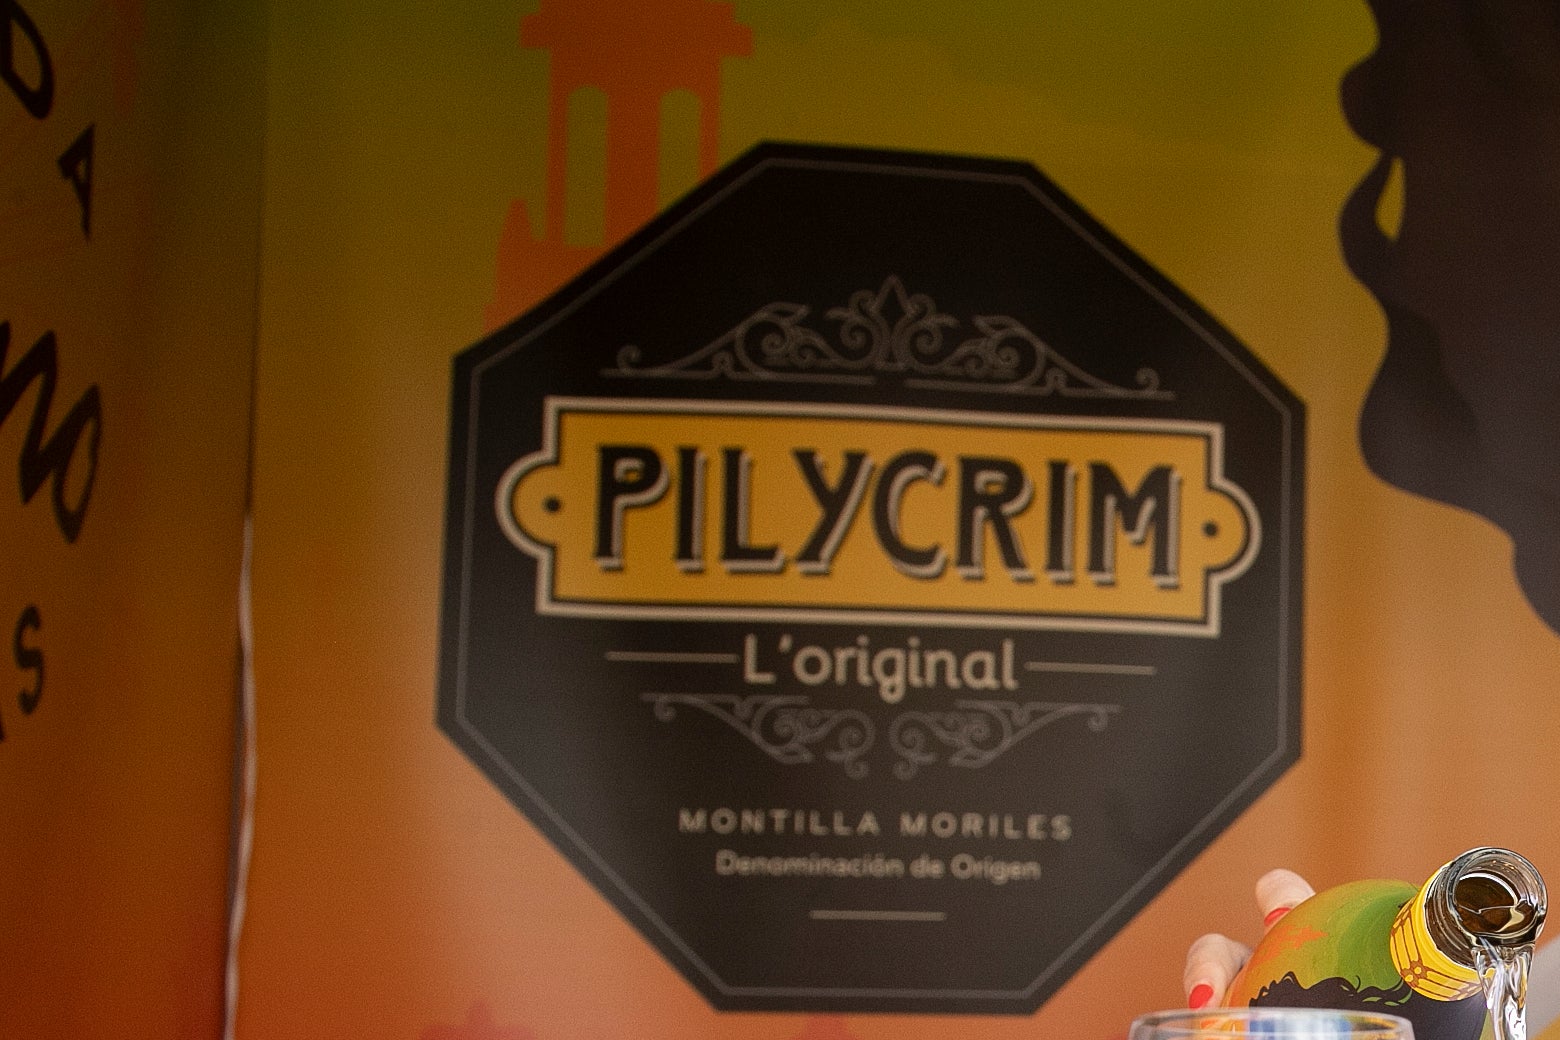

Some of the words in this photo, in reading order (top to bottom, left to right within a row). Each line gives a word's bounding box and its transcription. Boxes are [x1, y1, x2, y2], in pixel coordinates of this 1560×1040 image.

[593, 442, 1183, 589] PILYCRIM
[742, 633, 1019, 704] L'original
[678, 807, 882, 837] MONTILLA
[901, 810, 1073, 842] MORILES
[714, 847, 906, 879] Denominación
[909, 852, 946, 880] de
[949, 852, 1043, 886] Origen
